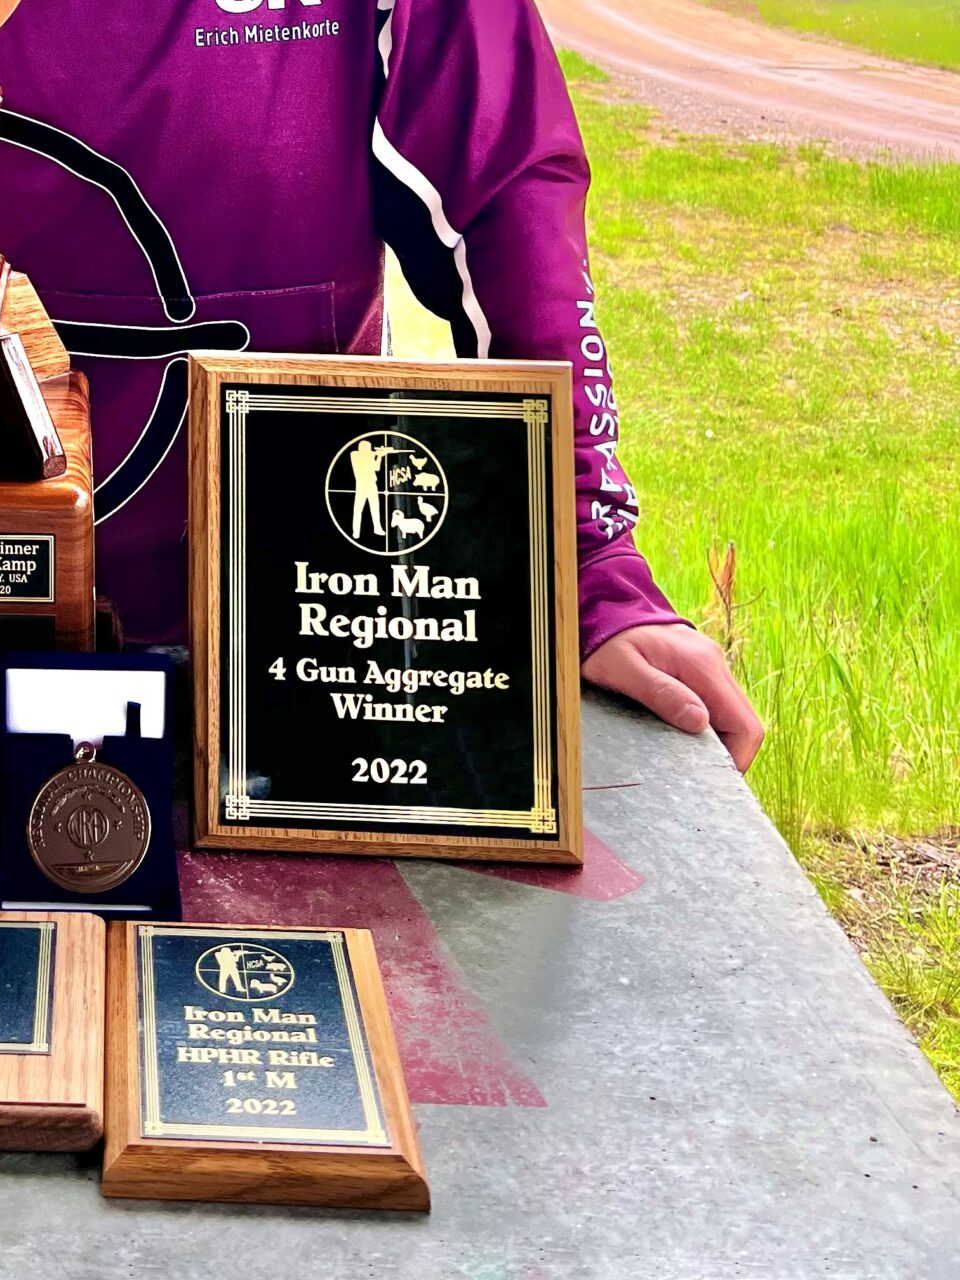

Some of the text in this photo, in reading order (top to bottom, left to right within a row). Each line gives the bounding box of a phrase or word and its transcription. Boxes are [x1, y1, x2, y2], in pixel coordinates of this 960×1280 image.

[195, 19, 340, 47] Erich Mietenkorte
[389, 465, 411, 488] HCSA
[8, 573, 28, 583] USA
[294, 560, 481, 600] Iron Man
[298, 602, 478, 649] Regional
[268, 657, 510, 695] 4 Gun Aggregate
[330, 693, 448, 723] Winner
[351, 757, 428, 785] 2022
[183, 1005, 318, 1025] Iron Man
[188, 1023, 318, 1045] Regional
[176, 1046, 336, 1068] HPHR Rifle
[222, 1070, 297, 1089] 1st M
[225, 1098, 297, 1115] 2022
